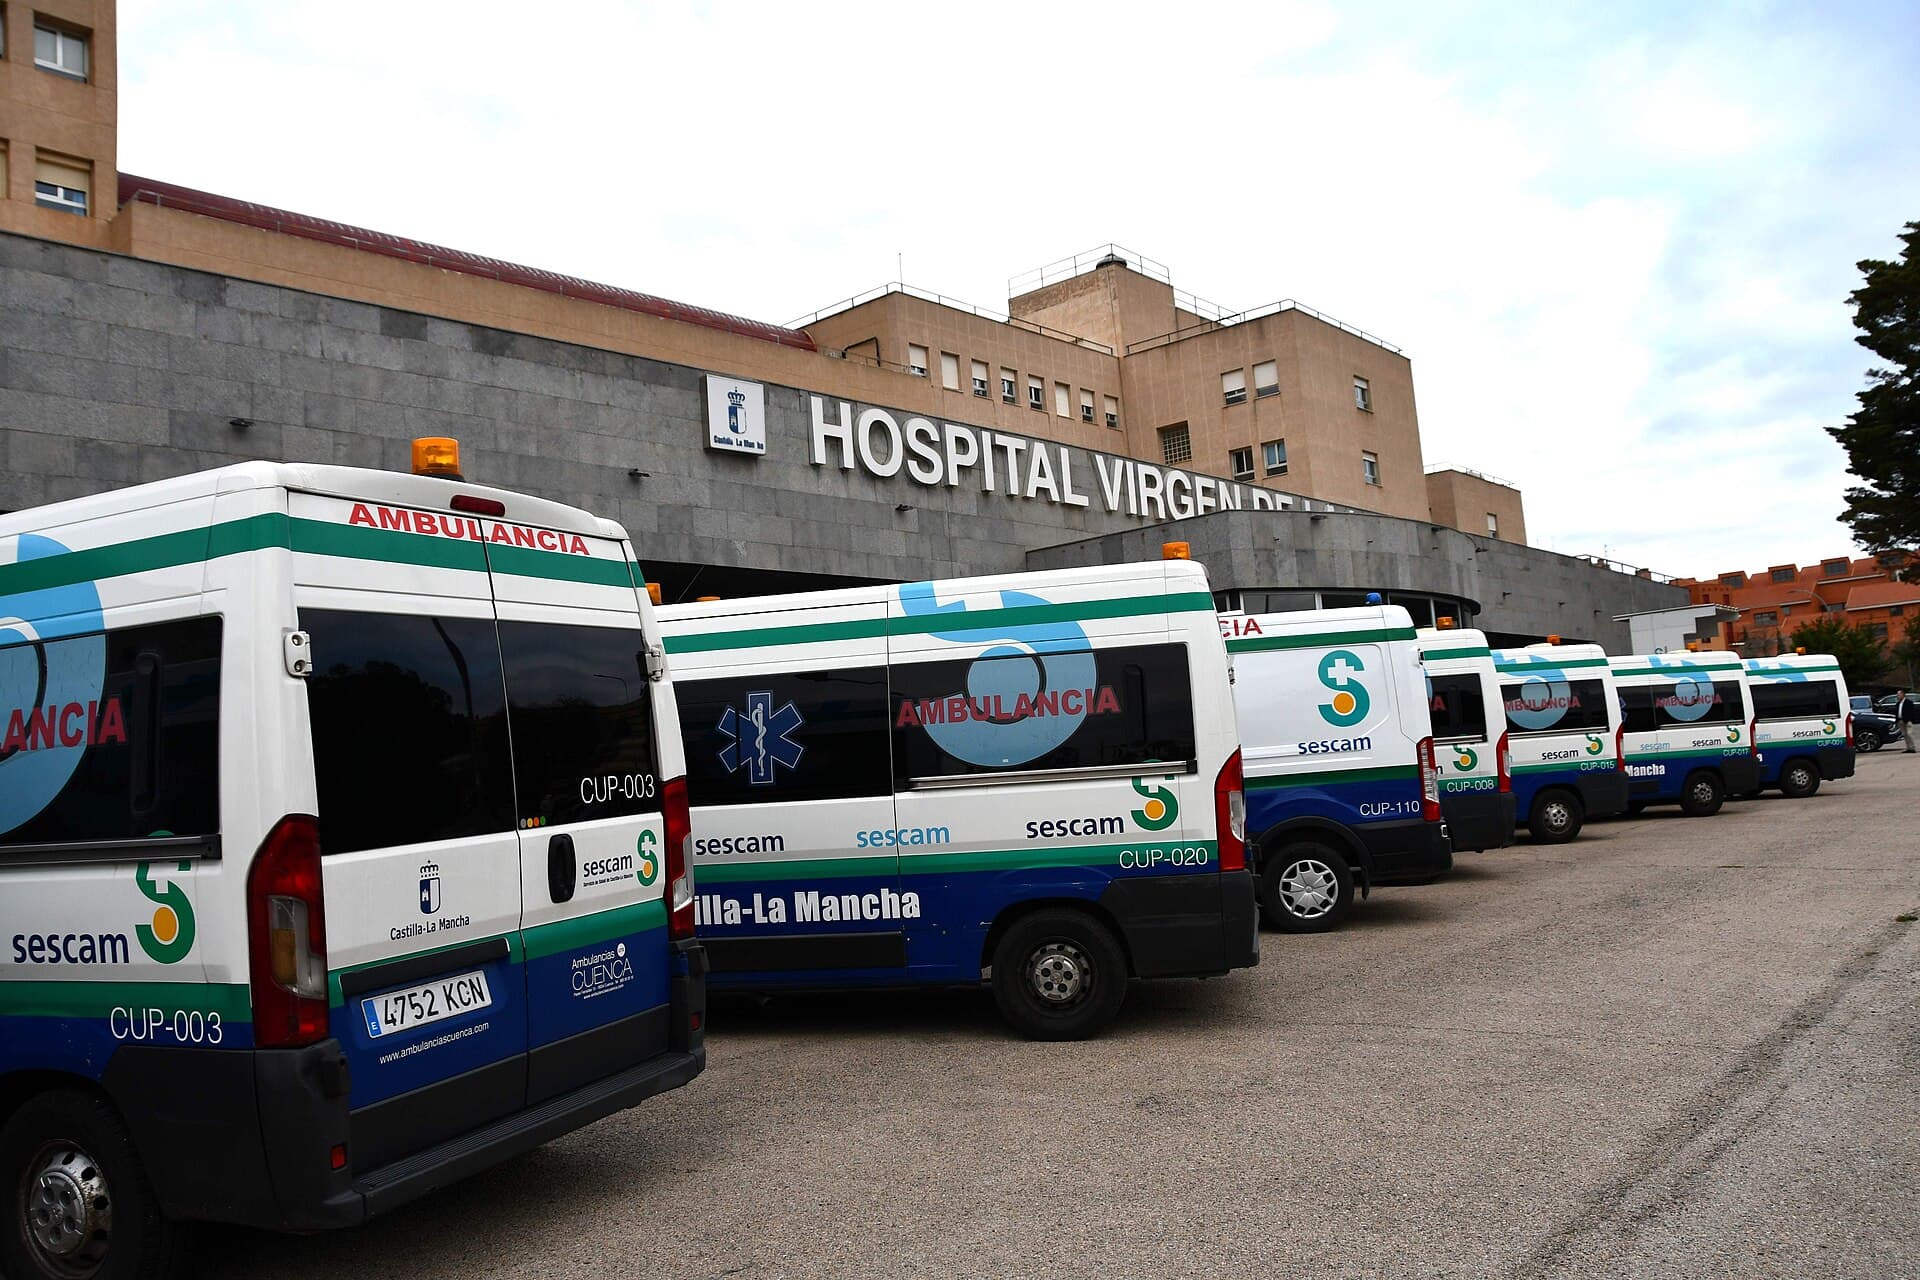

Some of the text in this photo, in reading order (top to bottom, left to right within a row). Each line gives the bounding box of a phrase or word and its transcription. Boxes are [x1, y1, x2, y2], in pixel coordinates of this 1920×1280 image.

[810, 395, 1089, 506] HOSPITAL
[1095, 455, 1242, 521] VIRGEN
[349, 503, 590, 556] AMBULANCIA
[896, 687, 1121, 728] AMBULANCIA
[1503, 696, 1582, 712] MBULANCIA
[1655, 694, 1723, 709] AMBULANCIA
[0, 698, 128, 752] ANCIA
[1792, 729, 1822, 738] sescam
[1298, 735, 1372, 756] sescam
[1541, 748, 1579, 761] sescam
[1640, 741, 1671, 752] sescam
[1692, 738, 1722, 748] sescam
[1580, 761, 1615, 771] CUP-015
[580, 774, 655, 804] CUP-003
[1446, 780, 1495, 793] CUP-008
[1359, 800, 1420, 816] CUP-110
[856, 826, 950, 848] sescam
[1025, 812, 1125, 840] sescam
[695, 834, 785, 856] sescam
[583, 854, 633, 878] sescam
[1118, 847, 1208, 869] CUP-020
[793, 888, 921, 923] Mancha
[390, 915, 470, 940] Castilla-La Mancha
[12, 932, 130, 965] sescam
[571, 950, 616, 970] Ambulancias
[572, 957, 633, 991] CUENCA
[370, 976, 486, 1031] E 4752 KCN
[110, 1007, 223, 1044] CUP-003
[379, 1022, 489, 1065] www.ambulanciascuenca.com
